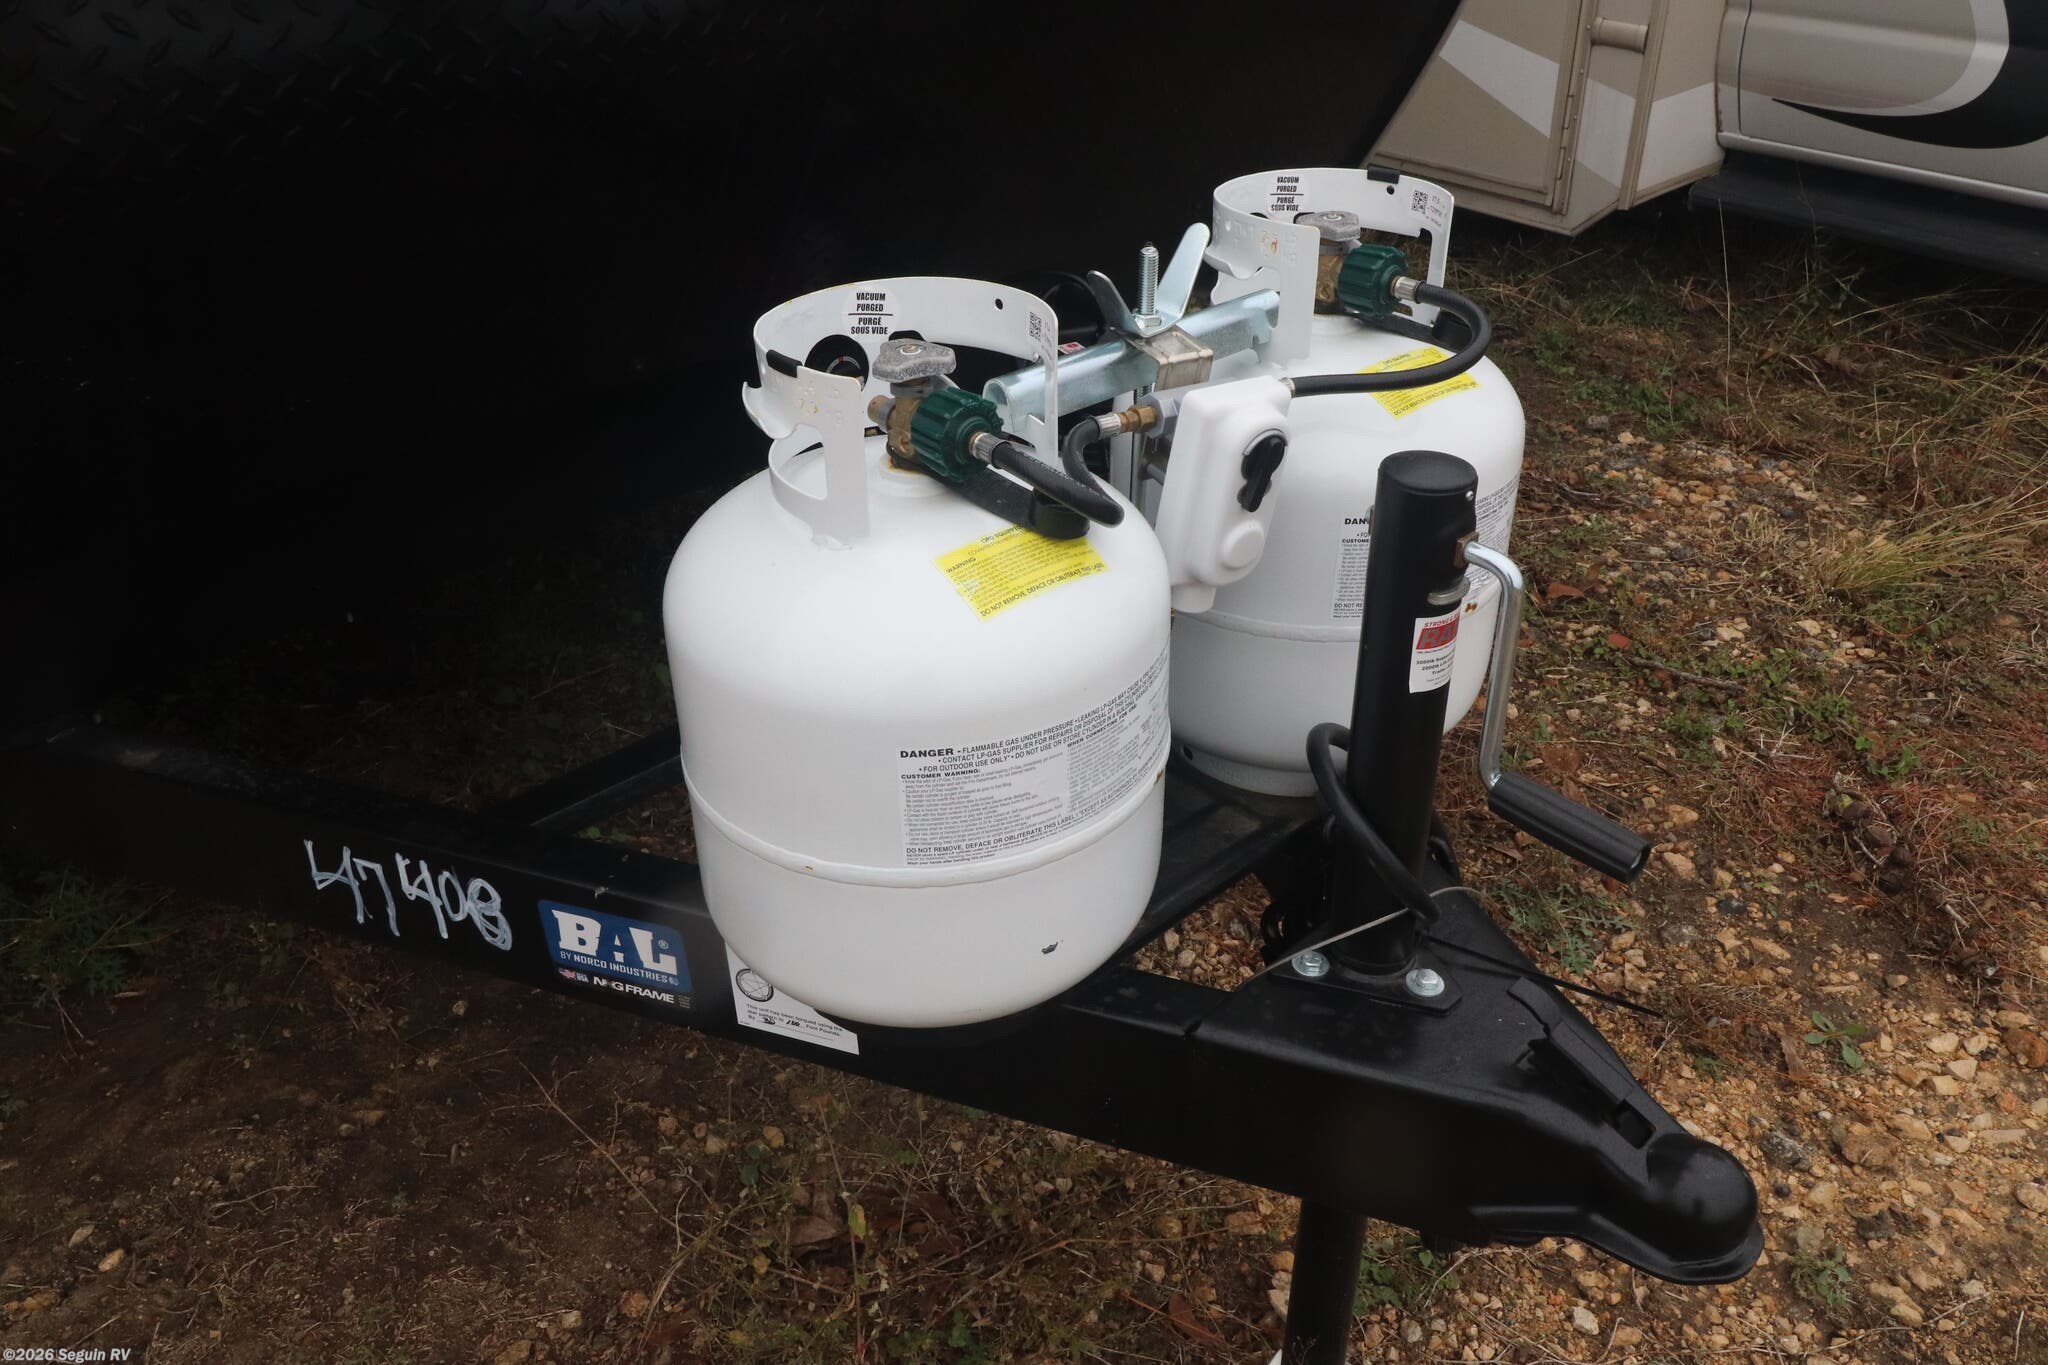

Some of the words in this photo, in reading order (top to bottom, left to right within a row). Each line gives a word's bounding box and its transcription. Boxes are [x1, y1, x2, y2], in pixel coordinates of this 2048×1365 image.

[856, 292, 886, 301] VACUUM
[856, 303, 884, 311] PURGED
[858, 315, 882, 325] PURGÉ
[850, 326, 870, 334] SOUS
[871, 326, 888, 334] VIDE
[980, 606, 992, 617] DO
[991, 599, 1005, 611] NOT
[900, 748, 955, 758] DANGER
[962, 739, 1004, 754] FLAMMABLE
[1004, 736, 1021, 746] GAS
[1020, 731, 1043, 743] UNDER
[1043, 719, 1075, 736] PRESSURE
[1078, 706, 1101, 722] LEAKING
[942, 754, 975, 764] CONTACT
[976, 749, 1002, 760] LP-GAS
[1002, 741, 1034, 755] SUPPLIER
[1034, 735, 1048, 746] FOR
[1048, 726, 1073, 741] REPAIRS
[1082, 711, 1108, 728] DISPOSAL
[923, 765, 938, 773] FOR
[940, 761, 974, 772] OUTDOOR
[974, 757, 989, 767] USE
[1015, 751, 1025, 759] DO
[1025, 746, 1039, 756] NOT
[1039, 742, 1052, 752] USE
[1053, 738, 1063, 746] OR
[1062, 730, 1081, 744] STORE
[1067, 738, 1084, 748] WHEN
[965, 839, 992, 849] DEFACE
[1003, 826, 1043, 843] OBLITERATE
[1043, 823, 1057, 832] THIS
[1056, 815, 1077, 826] LABEL
[560, 951, 571, 960] BY
[573, 954, 608, 969] NORCO
[609, 963, 669, 983] INDUSTRIES
[625, 984, 675, 1003] FRAME
